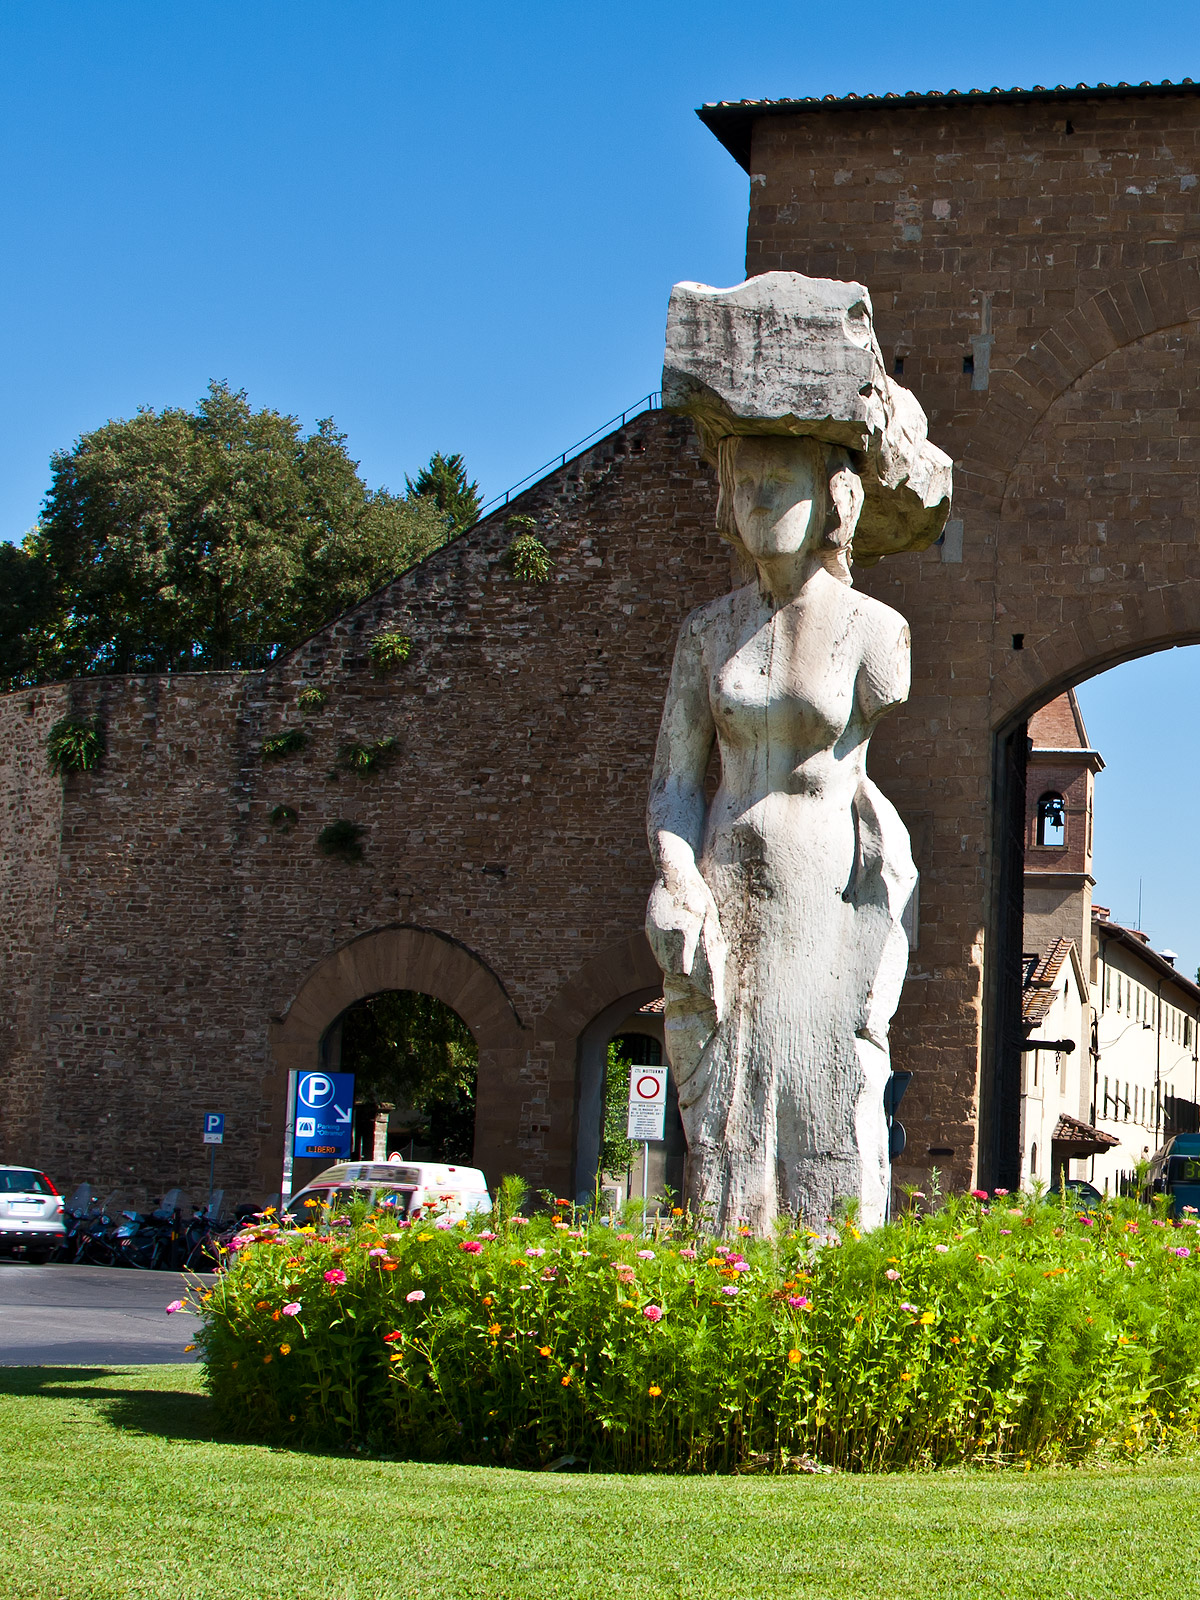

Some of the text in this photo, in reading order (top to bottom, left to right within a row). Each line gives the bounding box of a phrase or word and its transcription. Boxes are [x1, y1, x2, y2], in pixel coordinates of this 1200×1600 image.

[308, 1076, 331, 1104] P
[207, 1115, 221, 1132] P
[307, 1145, 336, 1154] LIBERO
